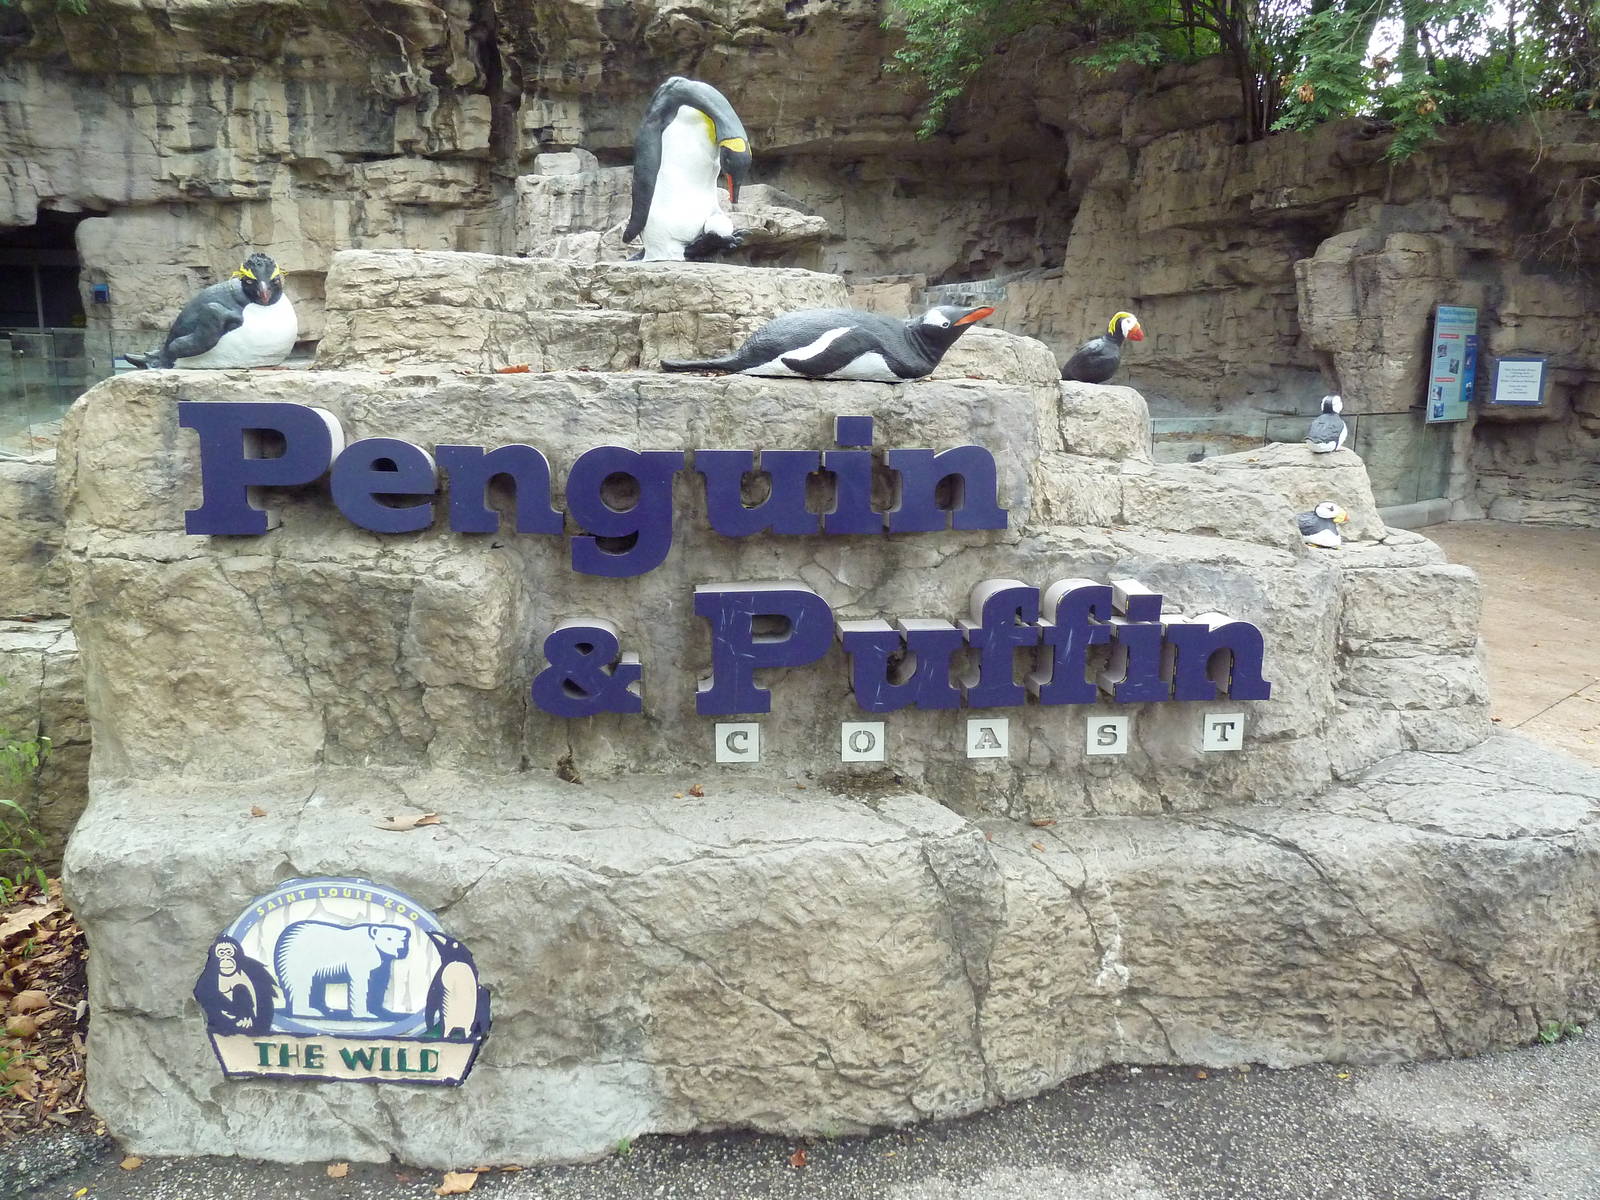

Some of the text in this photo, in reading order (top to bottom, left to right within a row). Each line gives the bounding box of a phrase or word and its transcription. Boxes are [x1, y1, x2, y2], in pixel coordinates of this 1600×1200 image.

[178, 401, 1008, 578] Penguin
[531, 579, 1271, 716] & Puffin
[725, 721, 1236, 755] COAST
[256, 887, 420, 922] SAINT LOUIS ZOO
[253, 1041, 440, 1074] THE WILD
